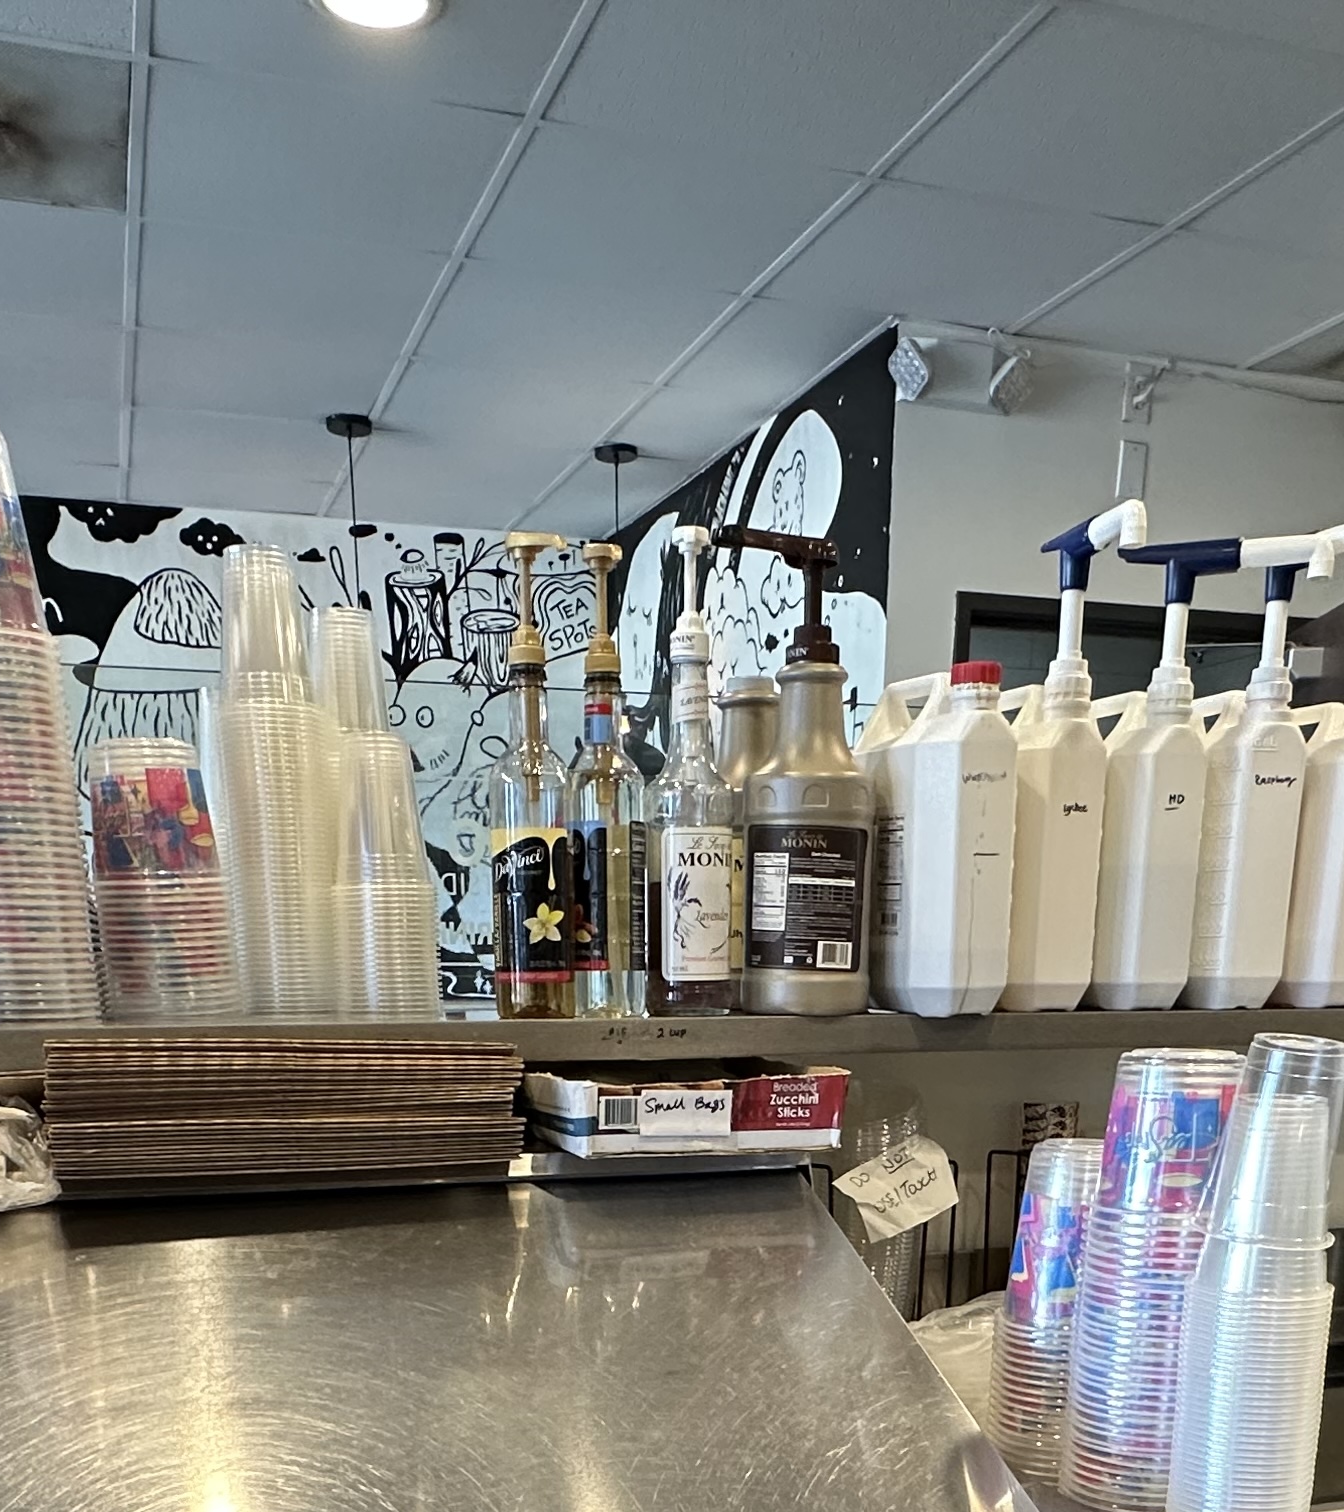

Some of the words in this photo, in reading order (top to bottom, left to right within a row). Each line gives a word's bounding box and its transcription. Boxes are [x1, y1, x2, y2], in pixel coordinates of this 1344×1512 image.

[549, 597, 590, 620] TEA
[780, 837, 829, 849] MONIN
[494, 846, 545, 883] DaVinci
[773, 1080, 820, 1094] Breaded
[644, 1096, 686, 1114] Small
[694, 1096, 728, 1112] Bags
[769, 1093, 820, 1106] Zucchini
[776, 1106, 812, 1119] Sticks
[881, 1145, 912, 1174] NOT
